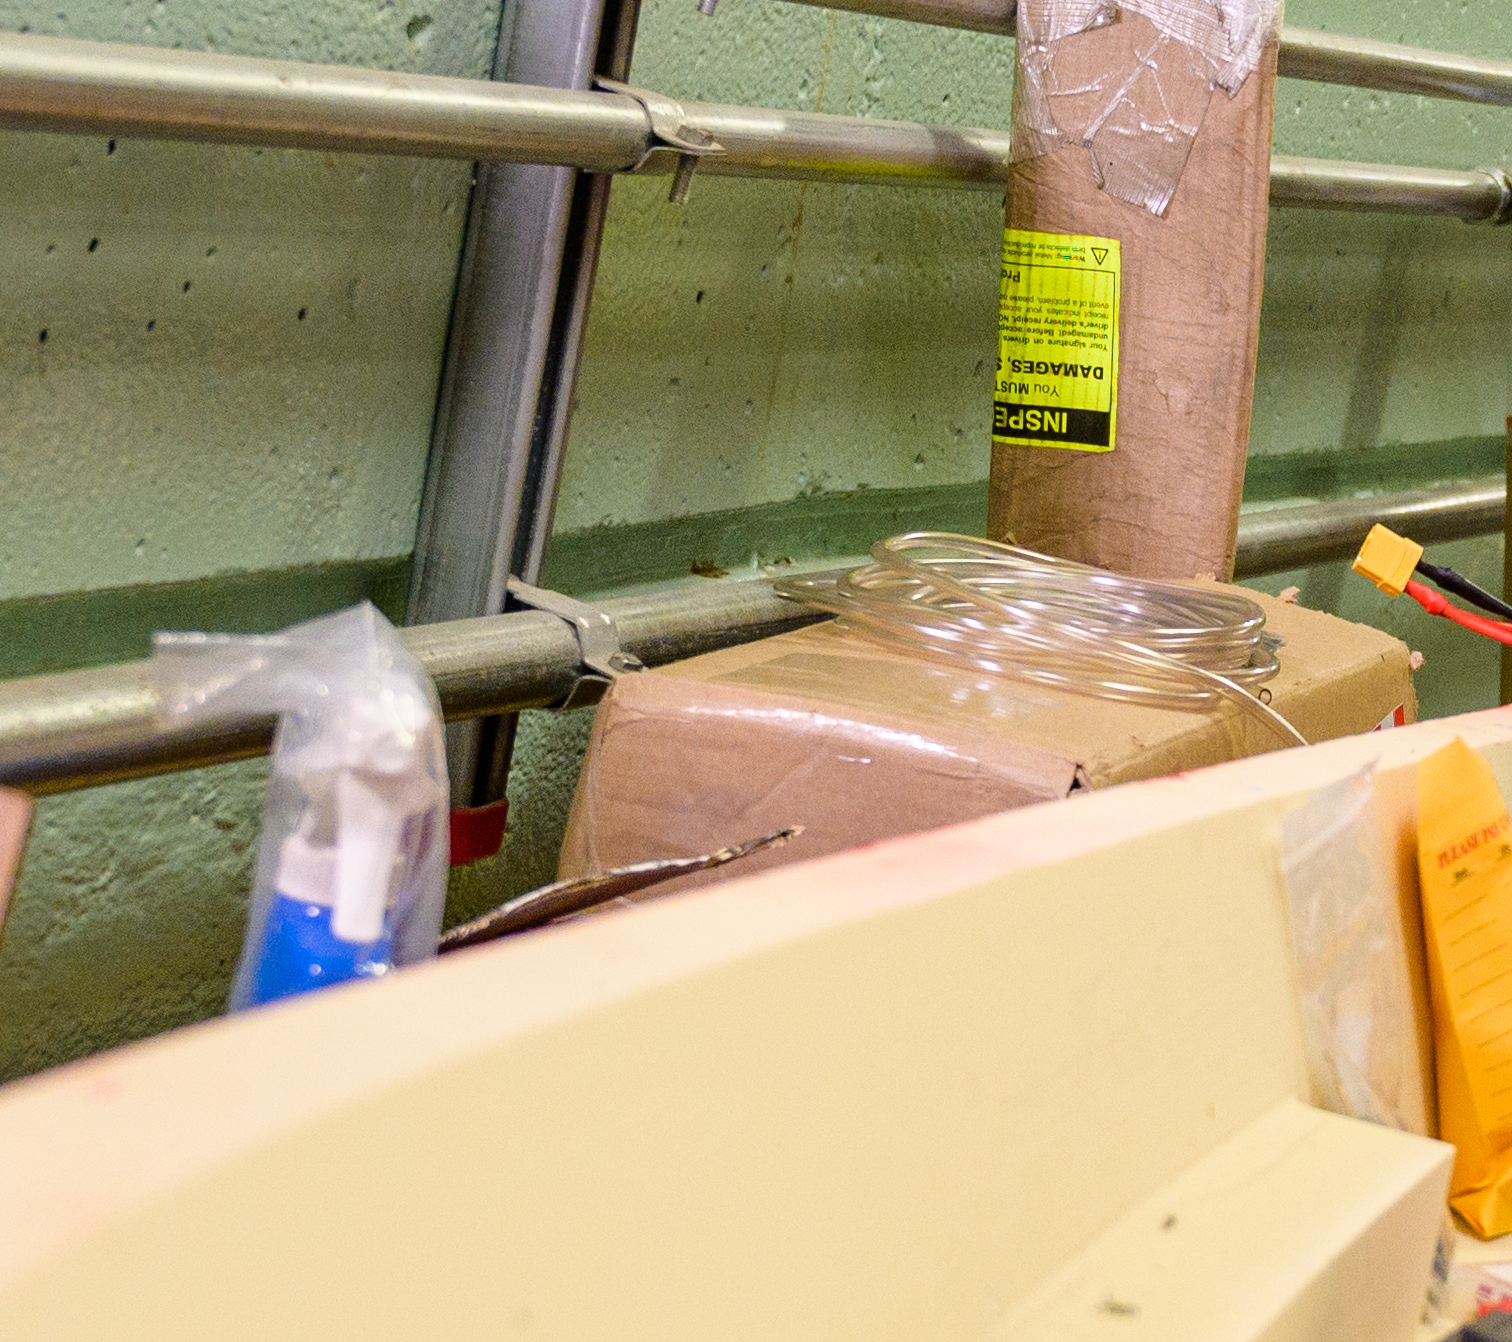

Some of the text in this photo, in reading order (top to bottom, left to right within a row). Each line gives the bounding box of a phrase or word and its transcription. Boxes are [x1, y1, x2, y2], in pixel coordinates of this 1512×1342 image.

[1009, 294, 1034, 303] please
[1026, 305, 1043, 315] your
[1046, 307, 1081, 317] indicates
[1084, 309, 1109, 320] receipt
[1044, 317, 1077, 327] delivery
[1026, 327, 1054, 336] Before
[1003, 335, 1108, 352] Your signature on drivers
[1008, 356, 1104, 380] DAMAGES,
[1034, 383, 1059, 397] You
